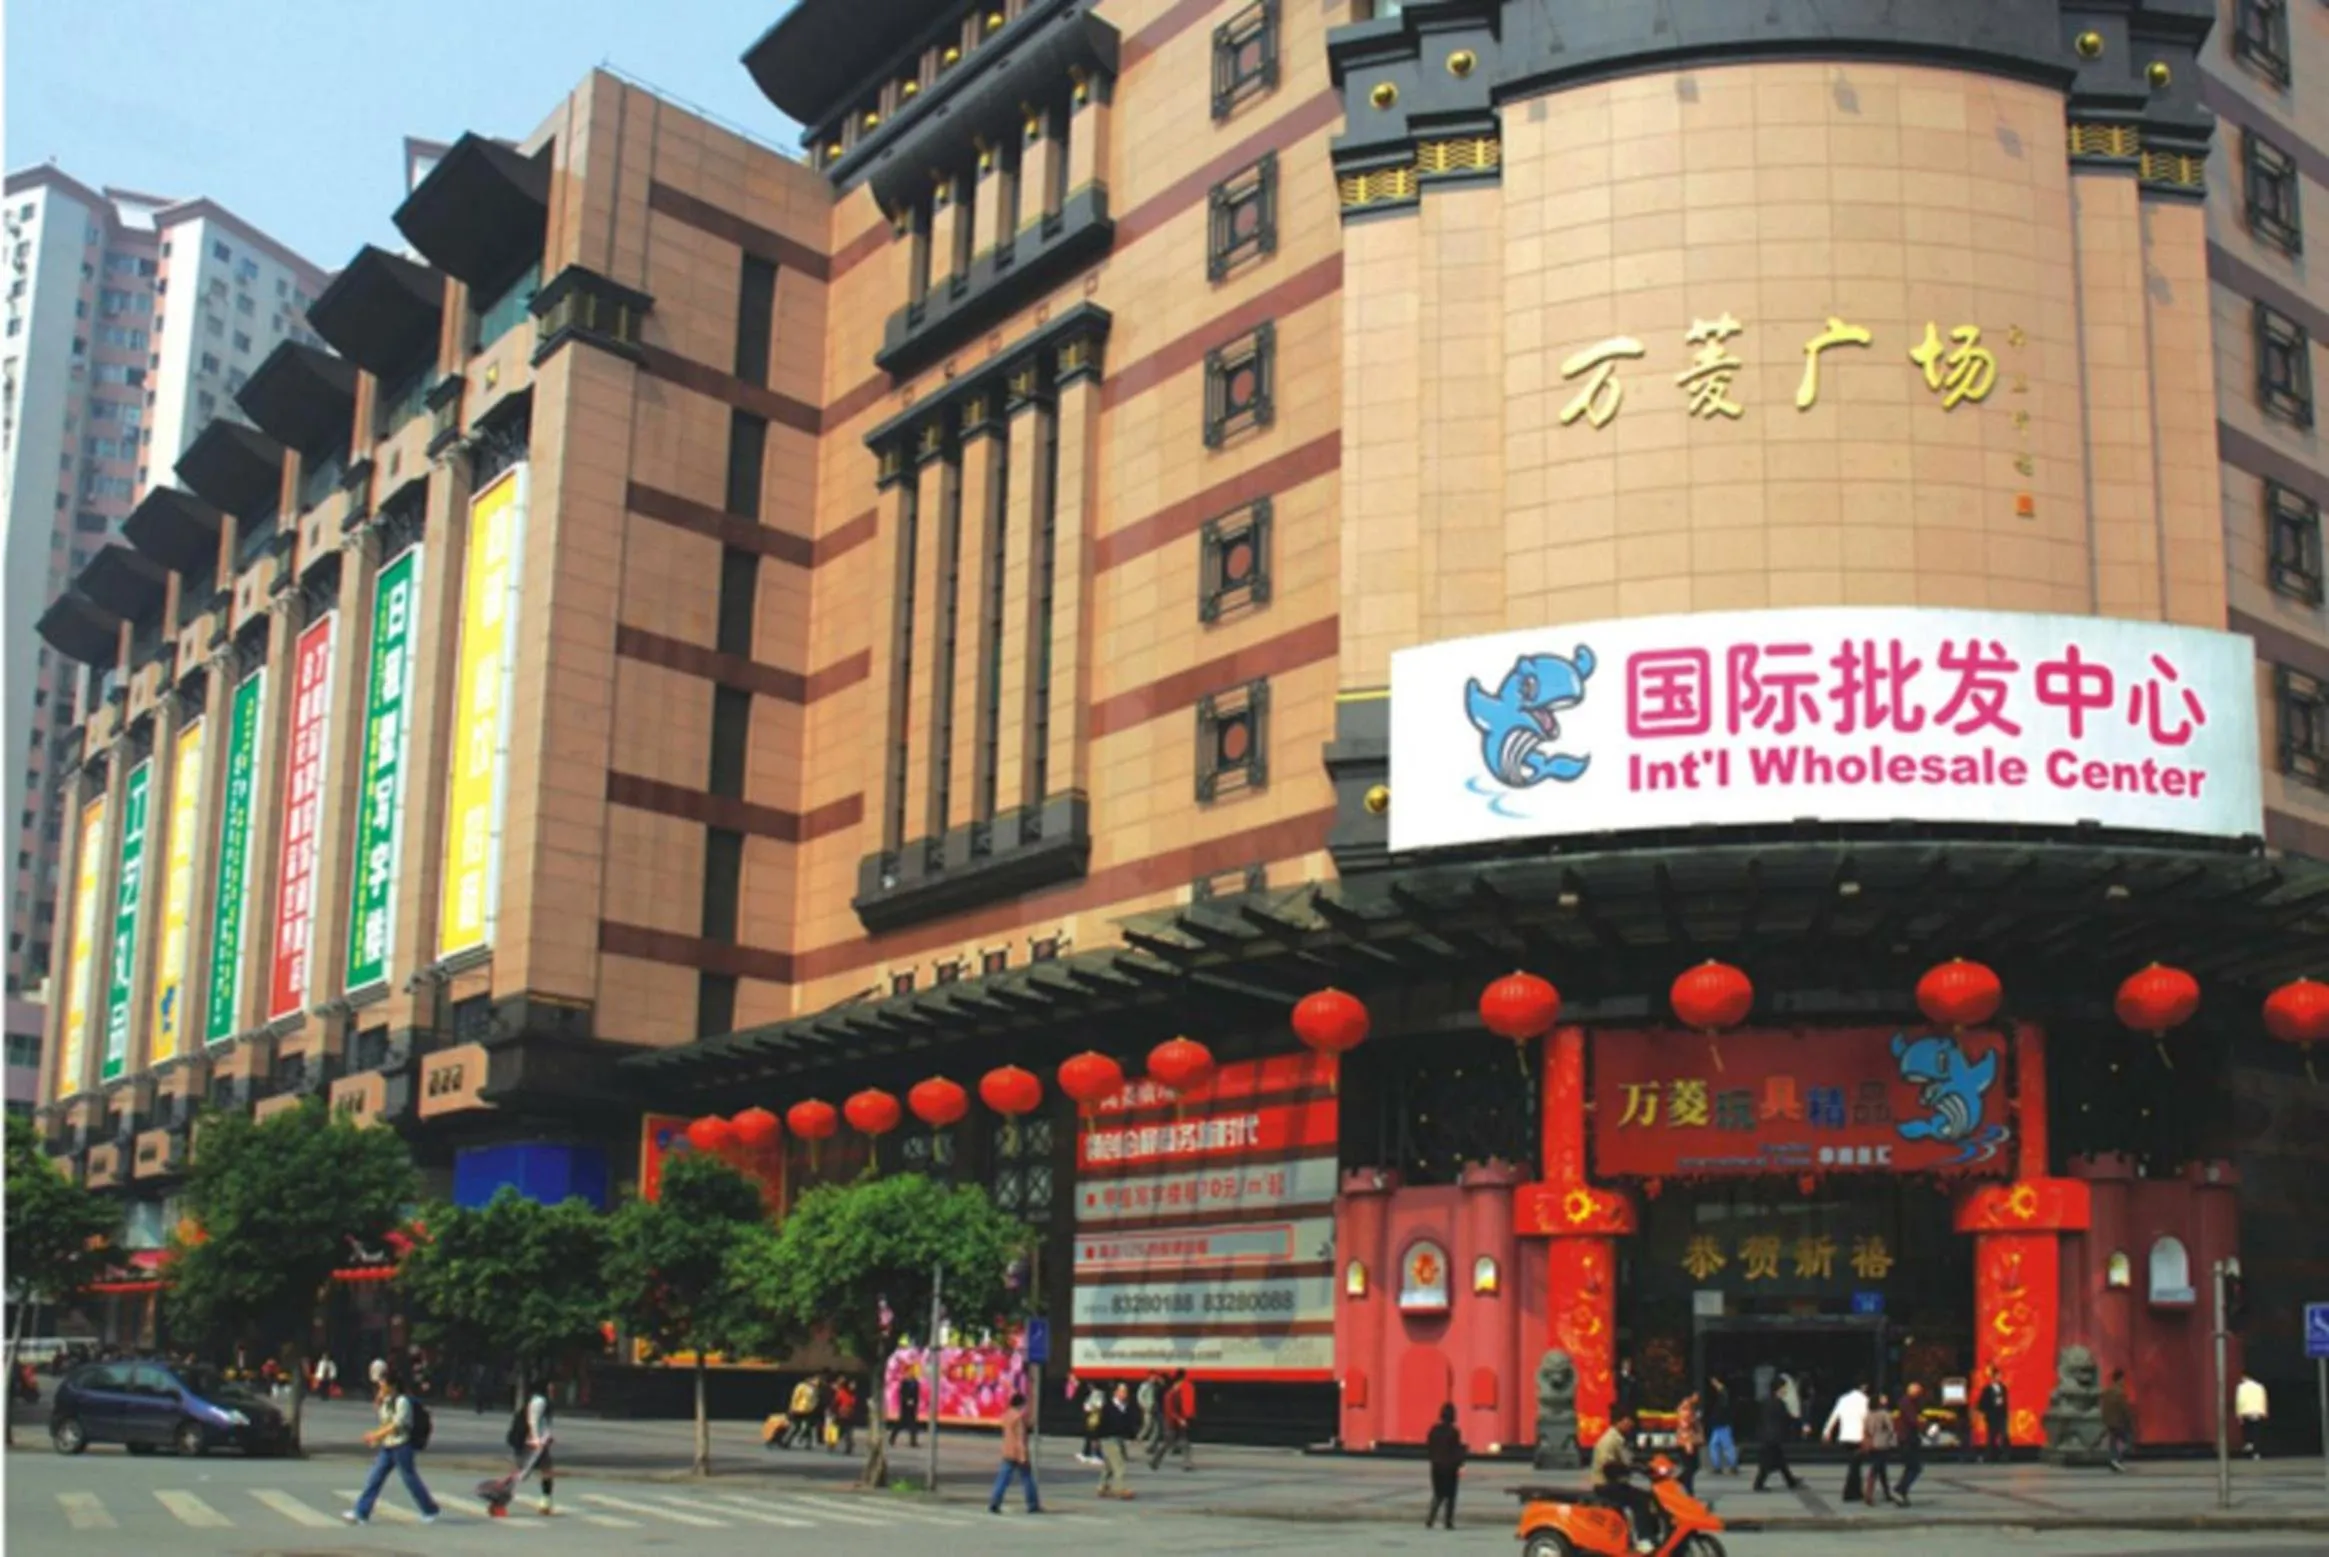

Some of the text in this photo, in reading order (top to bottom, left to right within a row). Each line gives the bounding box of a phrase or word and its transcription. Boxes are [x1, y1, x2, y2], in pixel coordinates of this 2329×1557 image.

[1559, 312, 1998, 430] 万菱广场
[1626, 637, 2206, 747] 国际批发中心
[1629, 745, 2206, 798] Int'l Wholesale Center
[1617, 1076, 1893, 1131] 万菱玩具精品
[1681, 1235, 1894, 1281] 恭贺新禧
